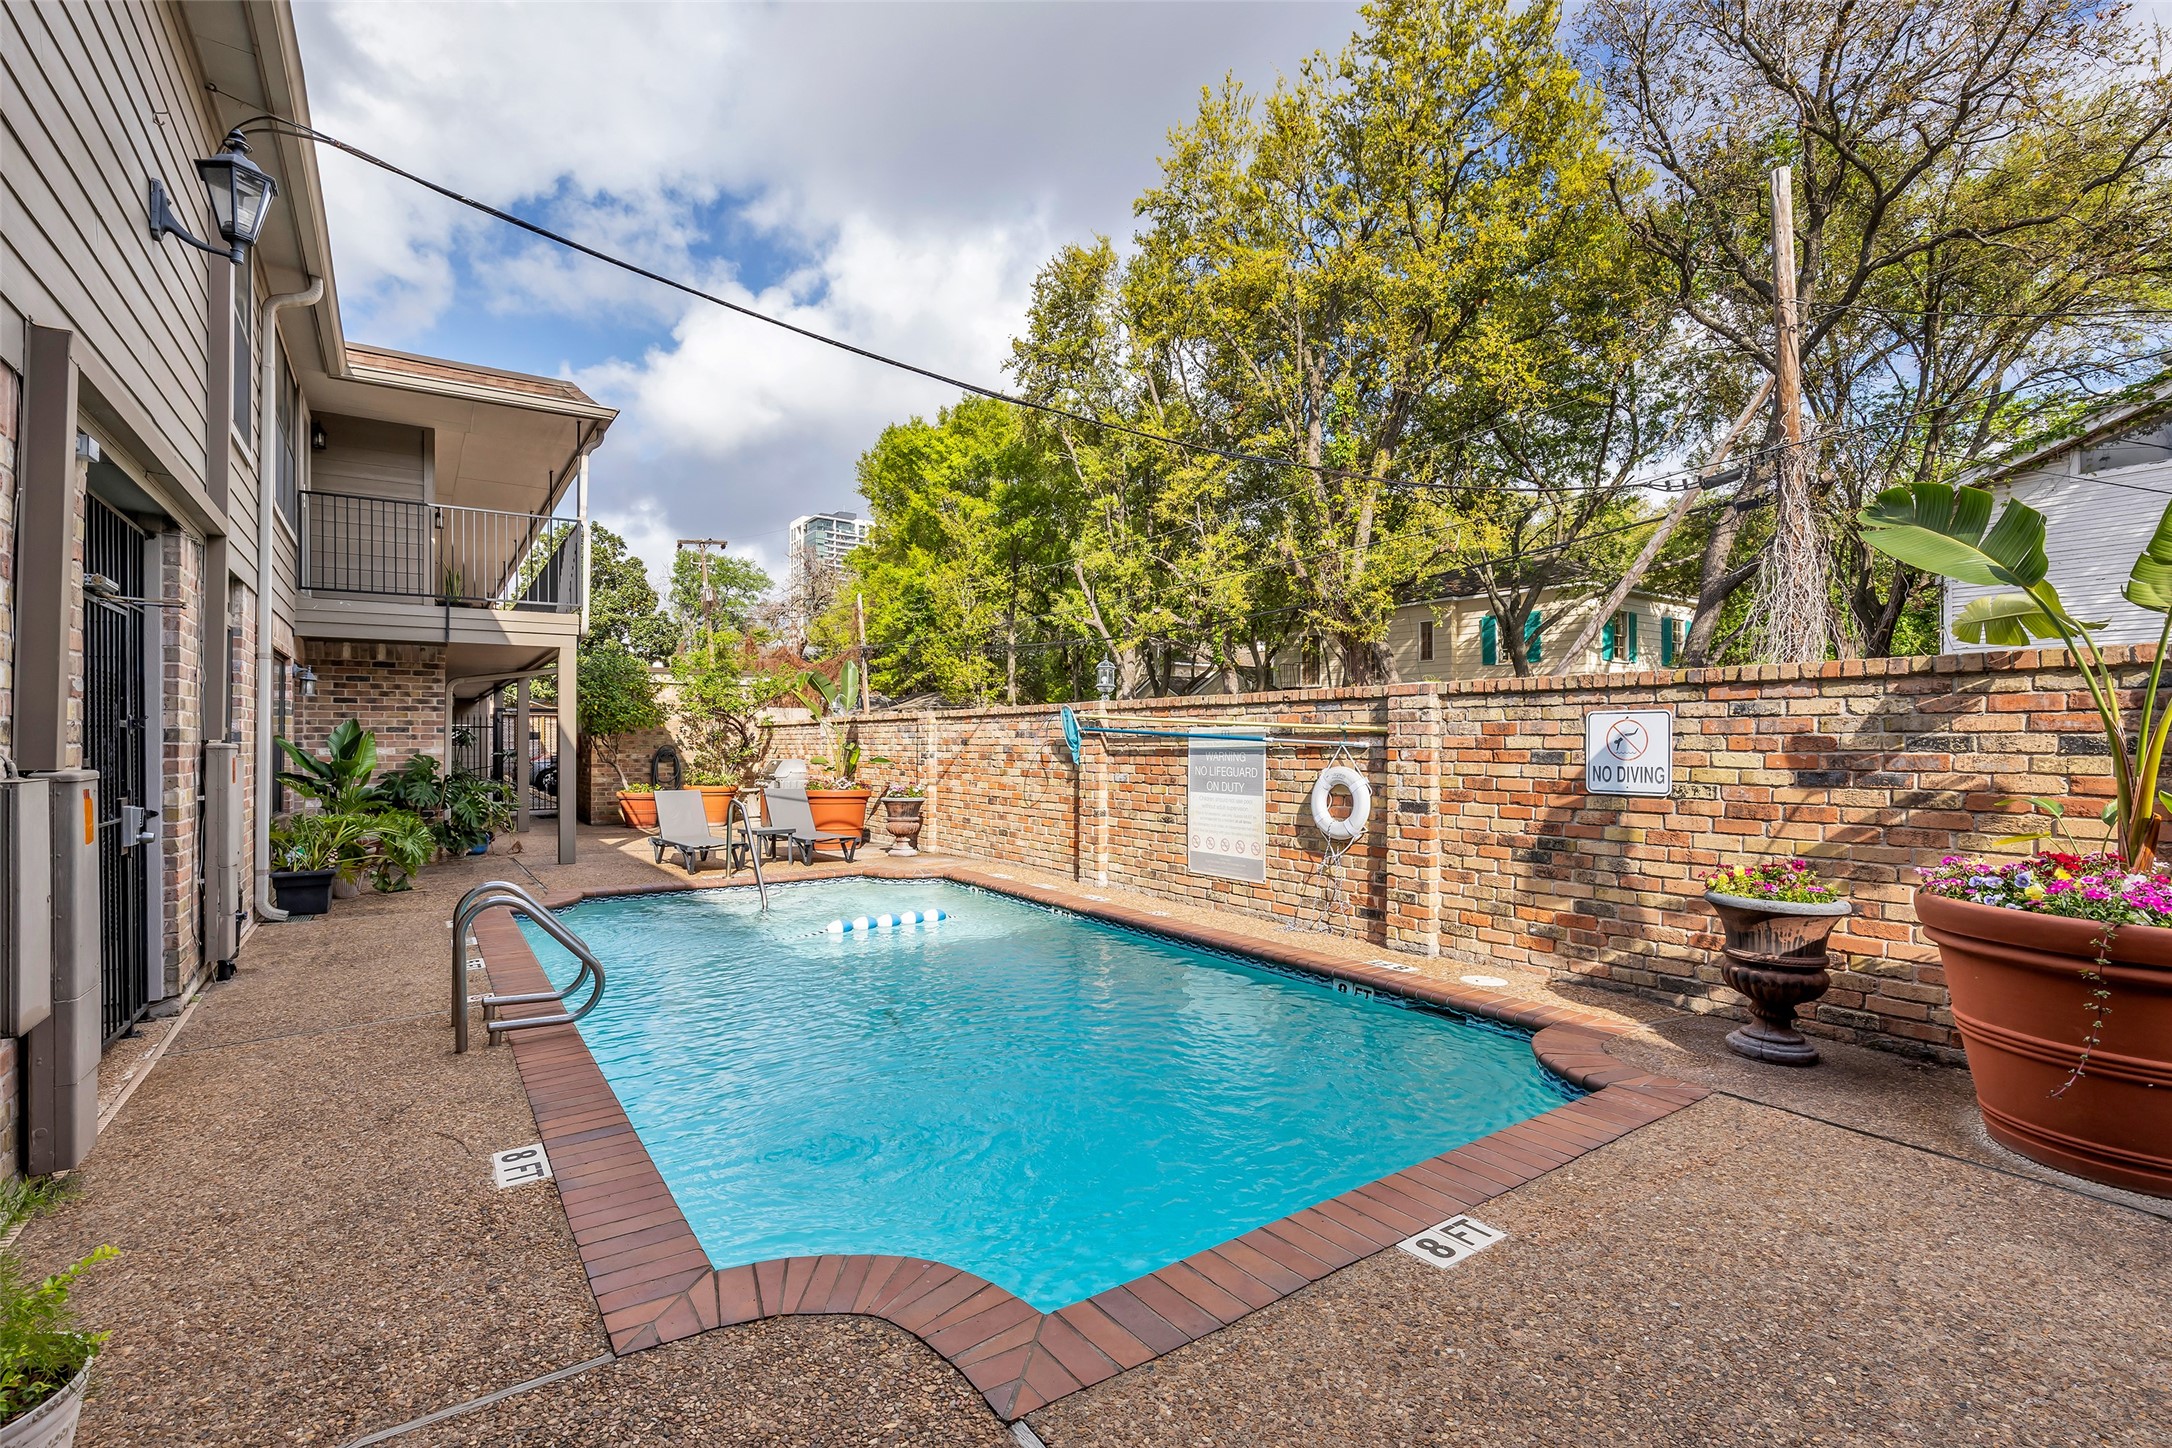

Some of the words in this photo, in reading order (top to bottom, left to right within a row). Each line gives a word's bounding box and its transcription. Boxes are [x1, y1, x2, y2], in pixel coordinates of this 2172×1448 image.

[1205, 751, 1246, 762] WARNING
[1194, 766, 1208, 776] NO
[1209, 766, 1258, 778] LIFEGUARD
[1592, 765, 1612, 783] NO
[1617, 766, 1665, 784] DIVING
[1206, 780, 1219, 791] ON
[1221, 781, 1245, 793] DUTY
[1353, 986, 1372, 1000] FT
[501, 1149, 538, 1163] 8
[503, 1162, 545, 1182] FT
[1415, 1238, 1457, 1259] 8
[1439, 1218, 1493, 1247] FT
